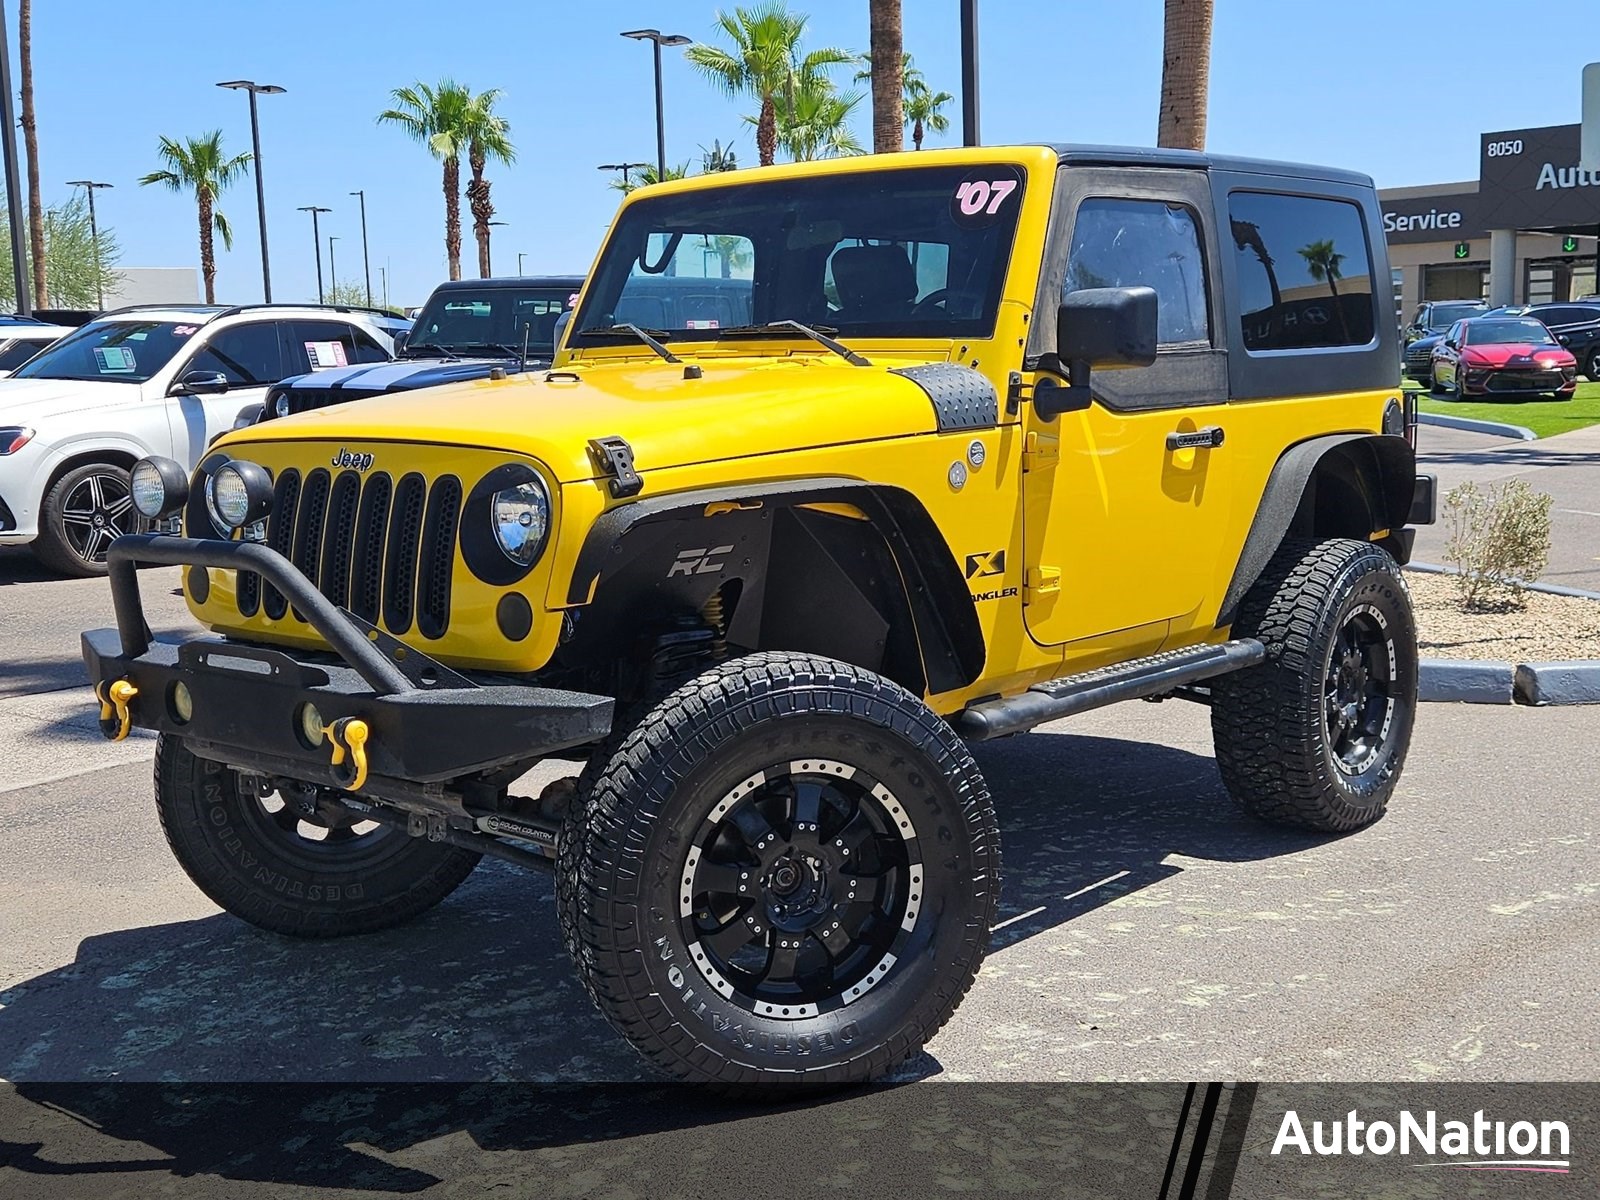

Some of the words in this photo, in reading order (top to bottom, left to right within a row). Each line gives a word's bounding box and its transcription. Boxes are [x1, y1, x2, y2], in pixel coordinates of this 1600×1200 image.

[1488, 140, 1523, 157] 8050
[1384, 209, 1462, 233] Service
[331, 447, 375, 473] Jeep
[666, 544, 735, 578] RC
[204, 783, 365, 902] DESTINATION
[654, 934, 861, 1056] DESTINATION
